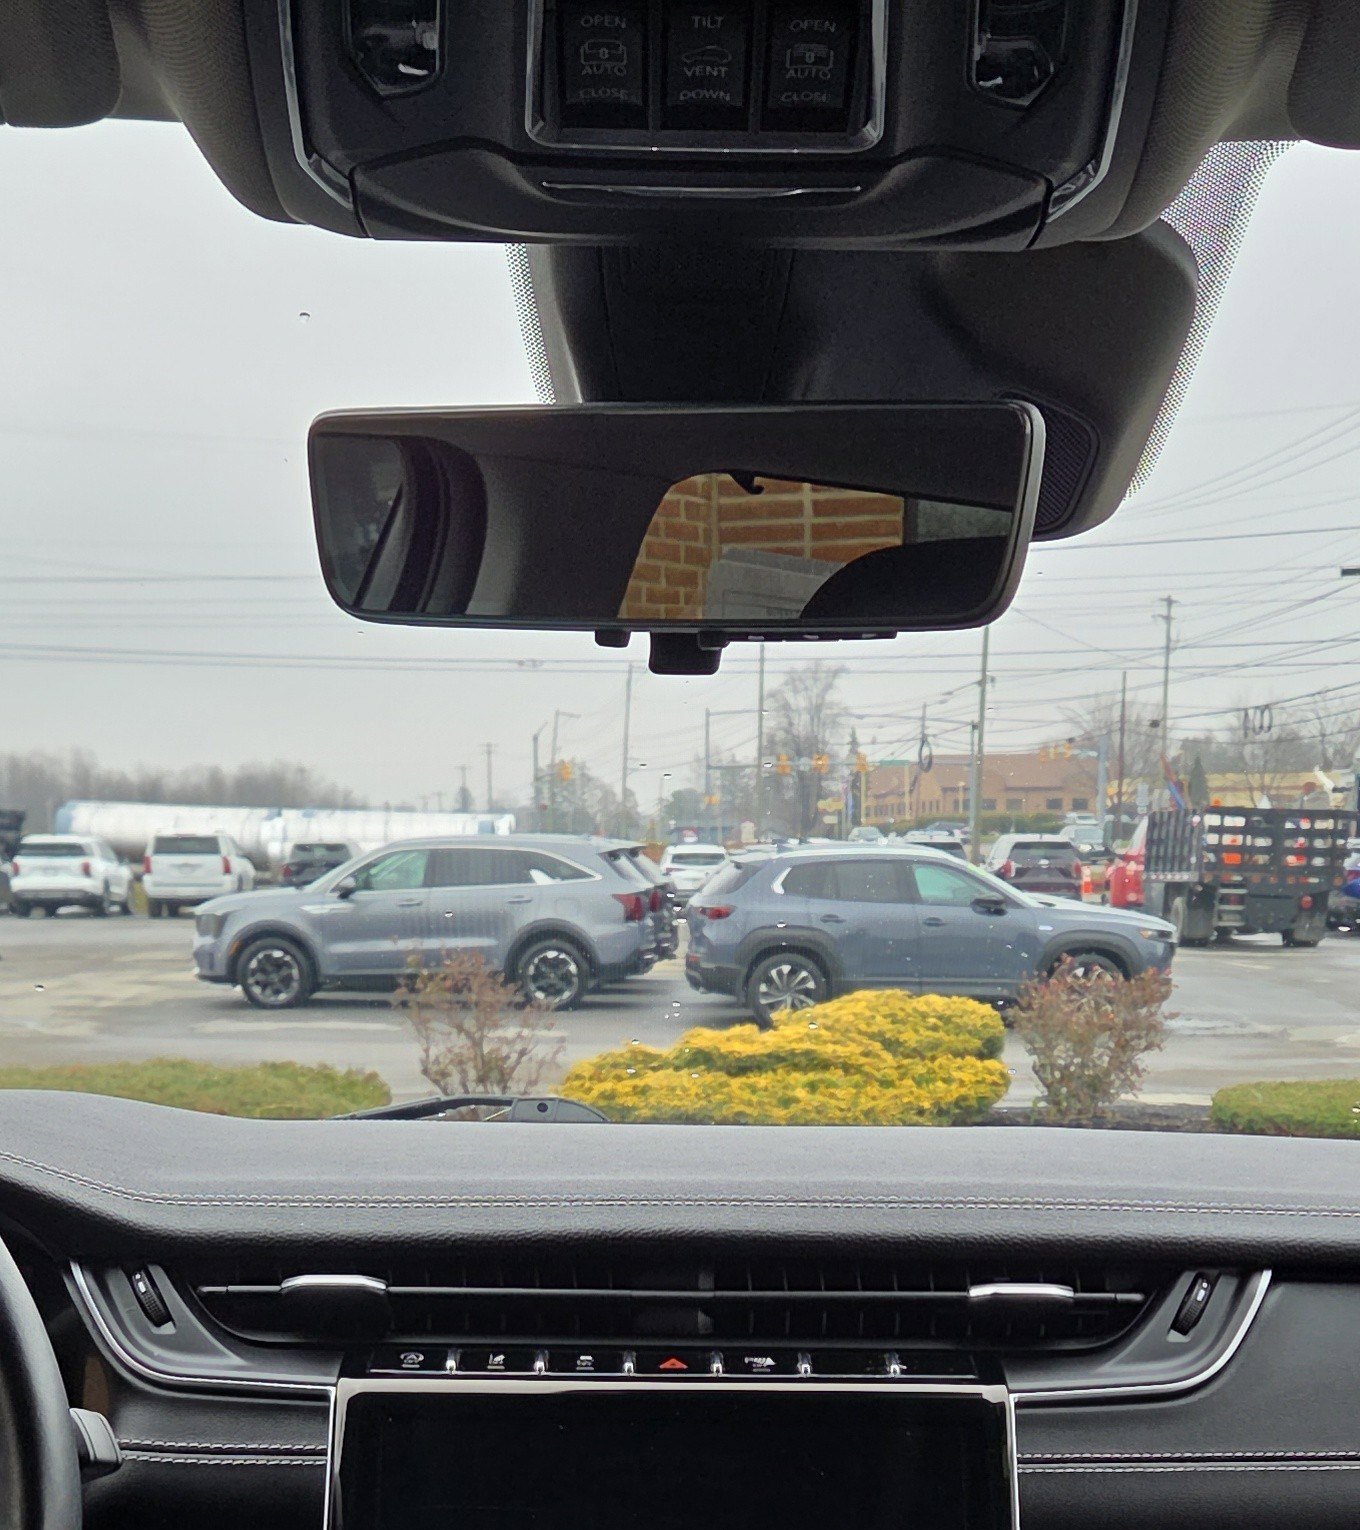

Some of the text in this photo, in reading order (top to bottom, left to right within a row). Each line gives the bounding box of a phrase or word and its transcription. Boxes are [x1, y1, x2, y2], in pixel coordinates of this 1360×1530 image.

[580, 15, 626, 28] OPEN
[692, 15, 724, 28] TILT
[789, 20, 837, 33] OPEN
[580, 65, 627, 76] AUTO
[684, 66, 728, 77] VENT
[786, 69, 831, 80] AUTO
[579, 88, 628, 100] CLOSE
[679, 90, 730, 102] DOWN
